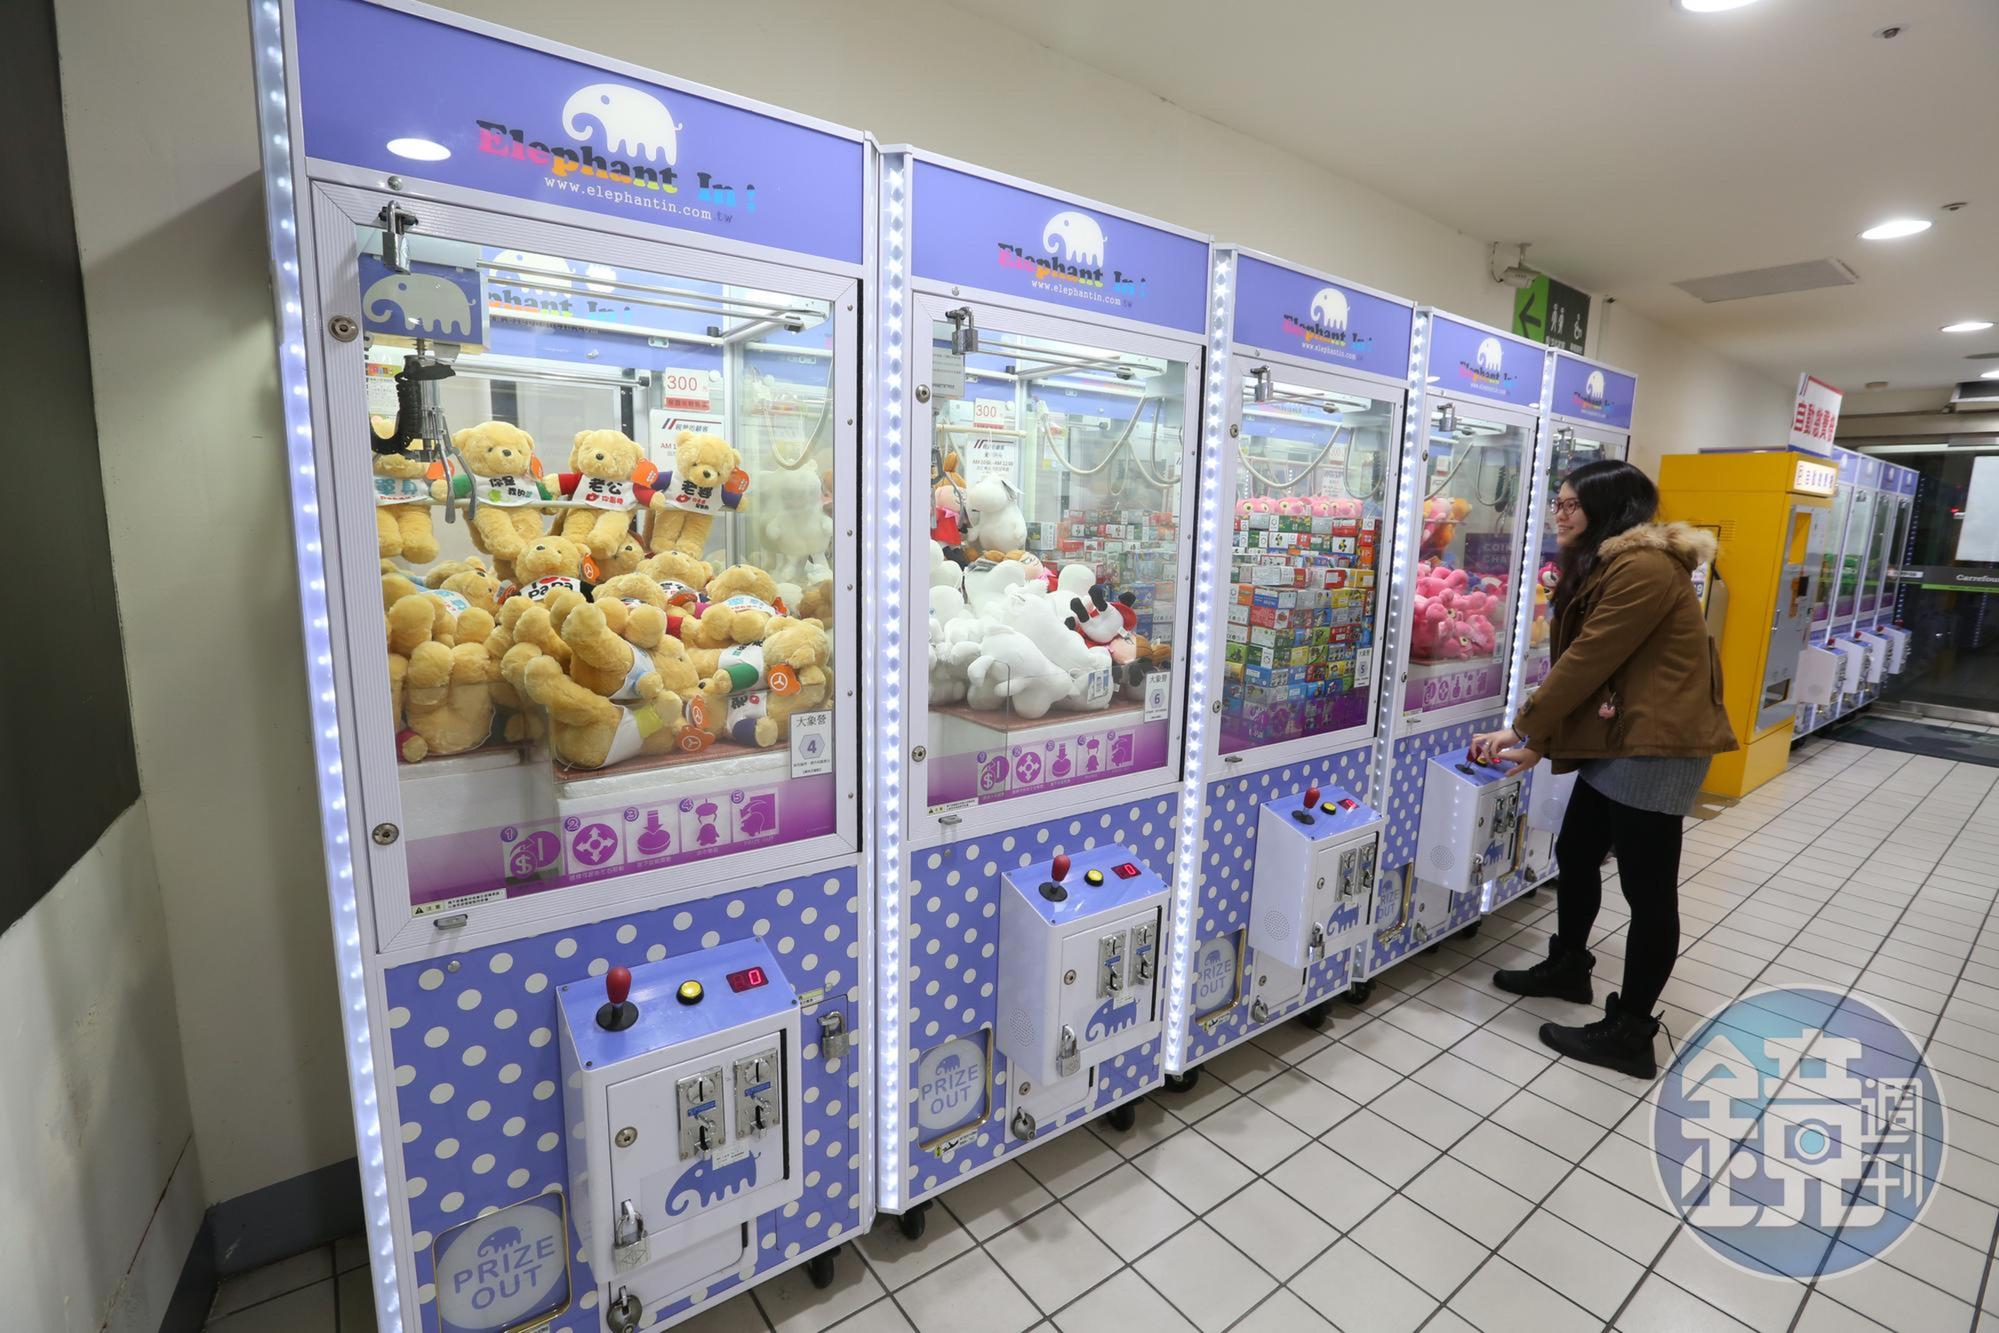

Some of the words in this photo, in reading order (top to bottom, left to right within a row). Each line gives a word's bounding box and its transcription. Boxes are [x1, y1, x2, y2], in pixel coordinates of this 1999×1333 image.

[476, 120, 678, 193] Elephant
[998, 243, 1104, 288] Elephant
[667, 375, 698, 391] 300
[976, 404, 997, 418] 300
[488, 475, 516, 488] 你是
[589, 477, 623, 496] 老公
[682, 480, 714, 499] 老婆
[1956, 574, 1999, 583] Carrefou
[1154, 693, 1160, 704] 6
[807, 740, 817, 754] 4
[1200, 976, 1226, 997] OUT
[921, 1063, 978, 1101] PRIZE
[931, 1085, 971, 1115] OUT
[453, 1235, 556, 1294] PRIZE
[471, 1264, 543, 1310] OUT
